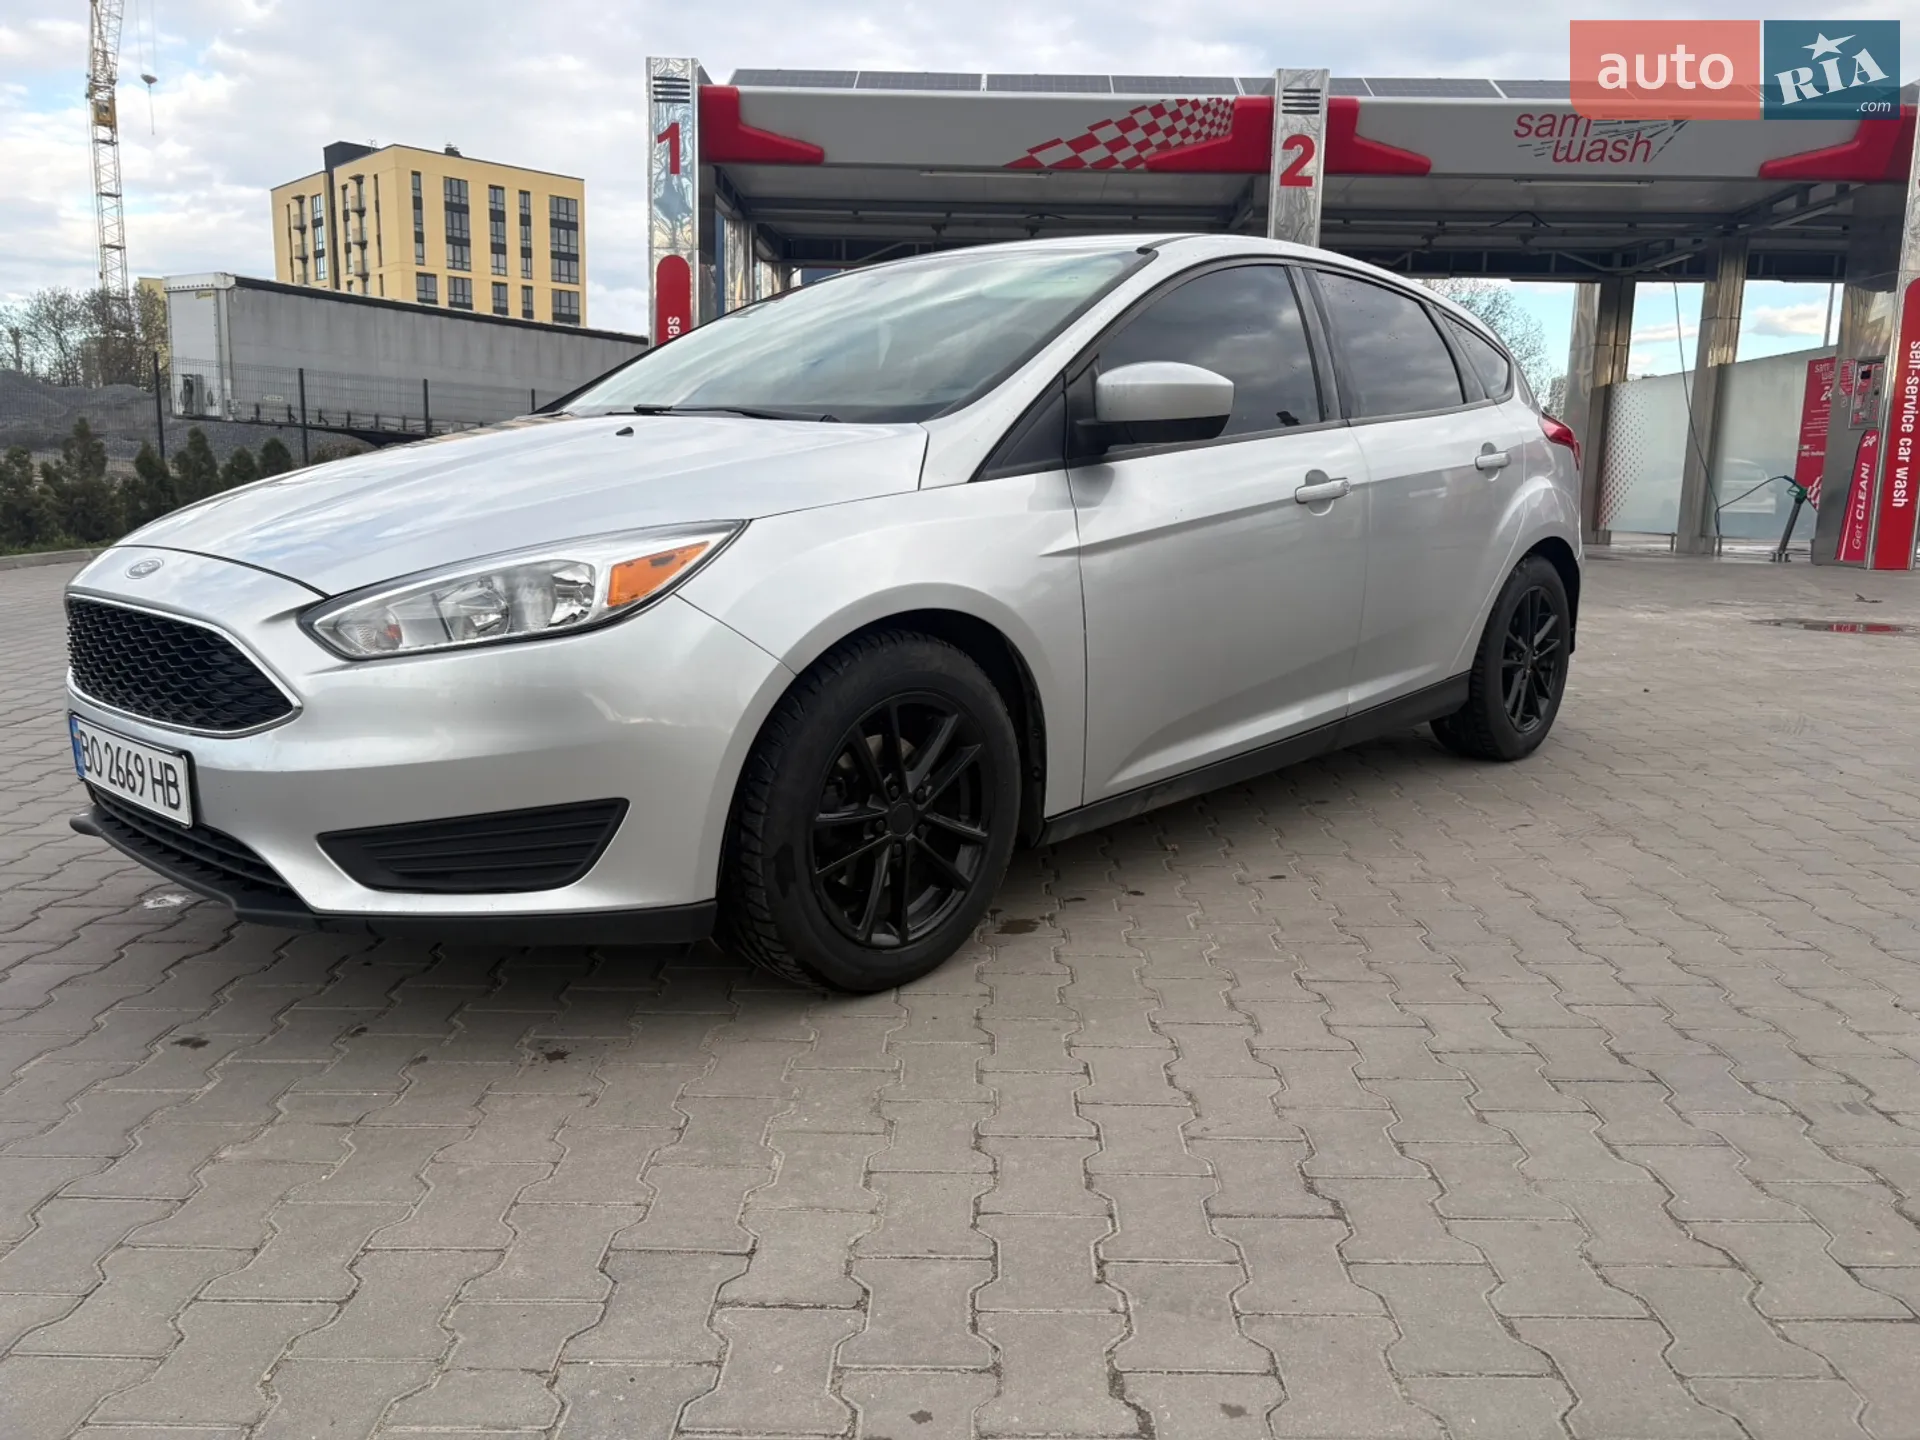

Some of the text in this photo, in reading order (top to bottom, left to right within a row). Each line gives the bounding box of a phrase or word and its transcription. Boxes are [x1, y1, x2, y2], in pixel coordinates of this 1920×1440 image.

[657, 122, 680, 174] 1
[1514, 113, 1592, 138] sam
[1552, 131, 1652, 163] wash
[1280, 134, 1315, 187] 2
[1892, 341, 1920, 508] self-service car wash
[1852, 523, 1862, 549] Get
[79, 729, 181, 811] BO 2669 HB
